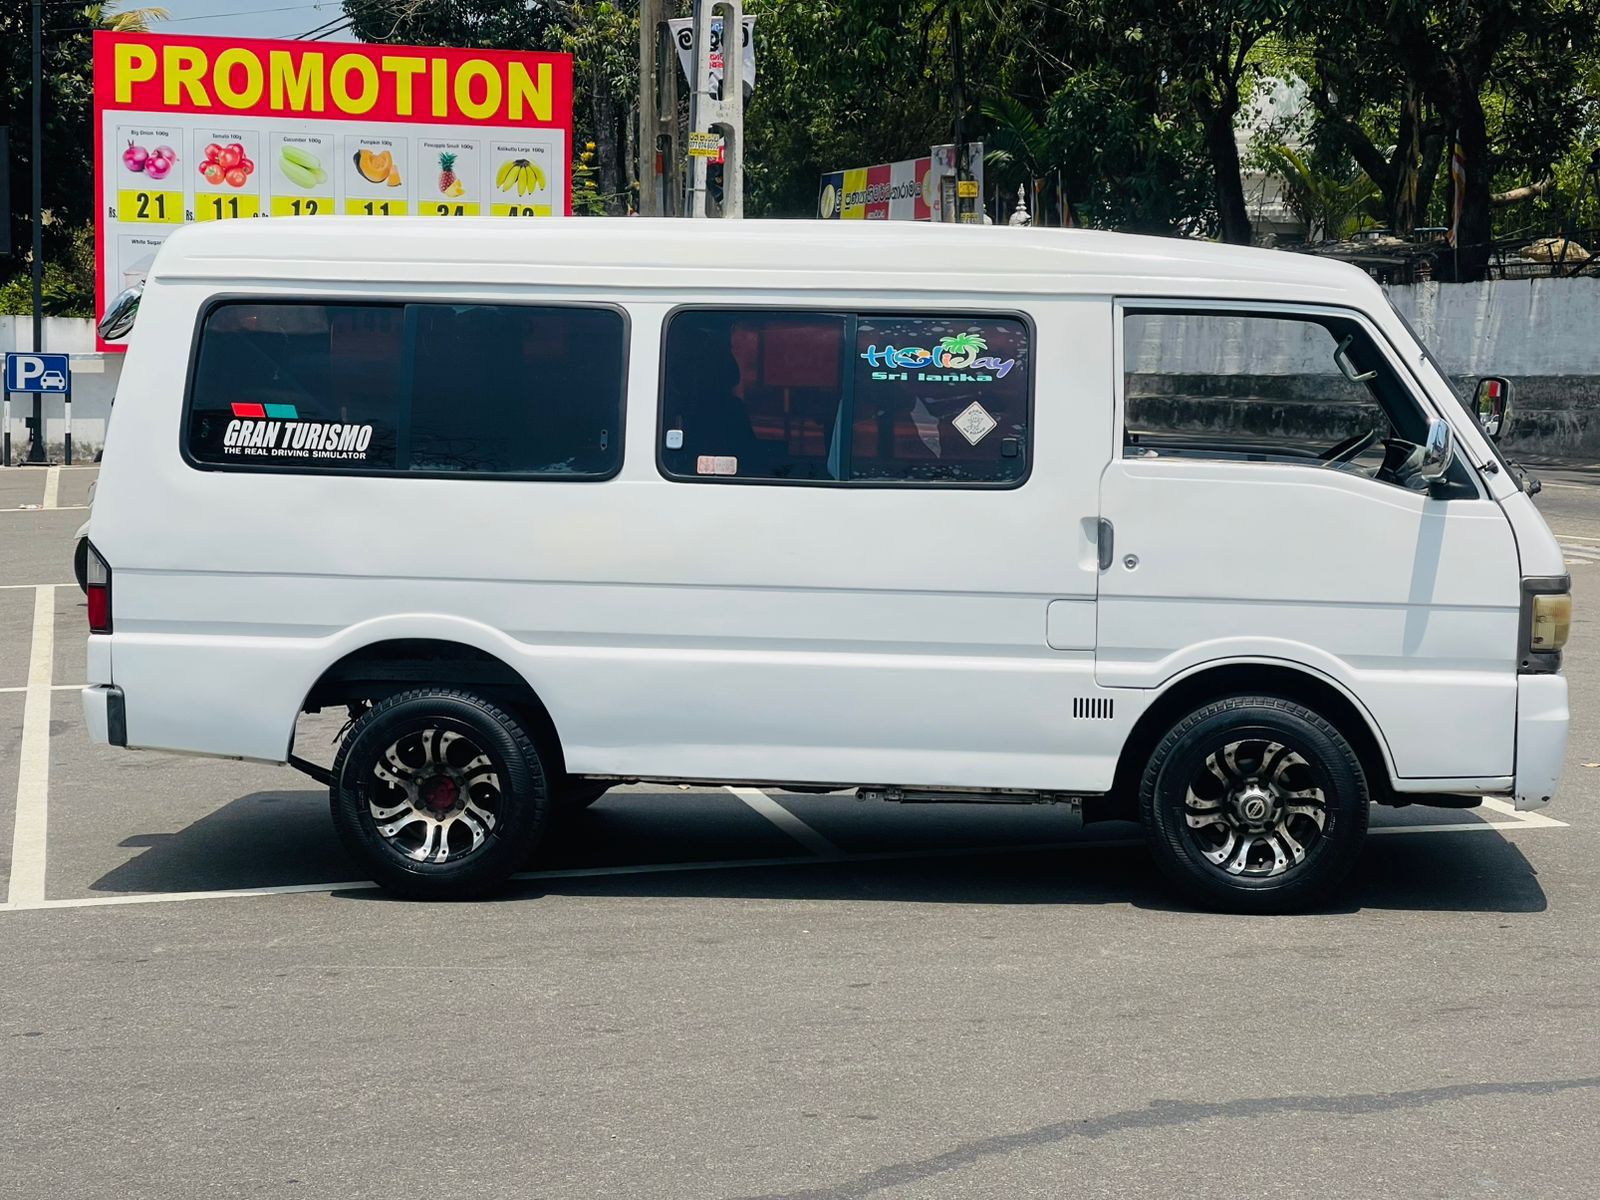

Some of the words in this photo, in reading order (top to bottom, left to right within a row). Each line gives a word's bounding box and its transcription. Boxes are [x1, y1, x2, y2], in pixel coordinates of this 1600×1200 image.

[114, 42, 553, 122] PROMOTION
[108, 206, 118, 218] Rs.
[136, 192, 165, 219] 21
[185, 209, 196, 221] Rs.
[213, 196, 238, 220] 11
[16, 356, 45, 389] P
[871, 372, 908, 381] Sri
[223, 419, 281, 448] GRAN
[281, 422, 373, 452] TURISMO
[223, 446, 242, 455] THE
[244, 447, 268, 456] REAL
[271, 448, 310, 458] DRIVING
[312, 451, 367, 460] SIMULATOR
